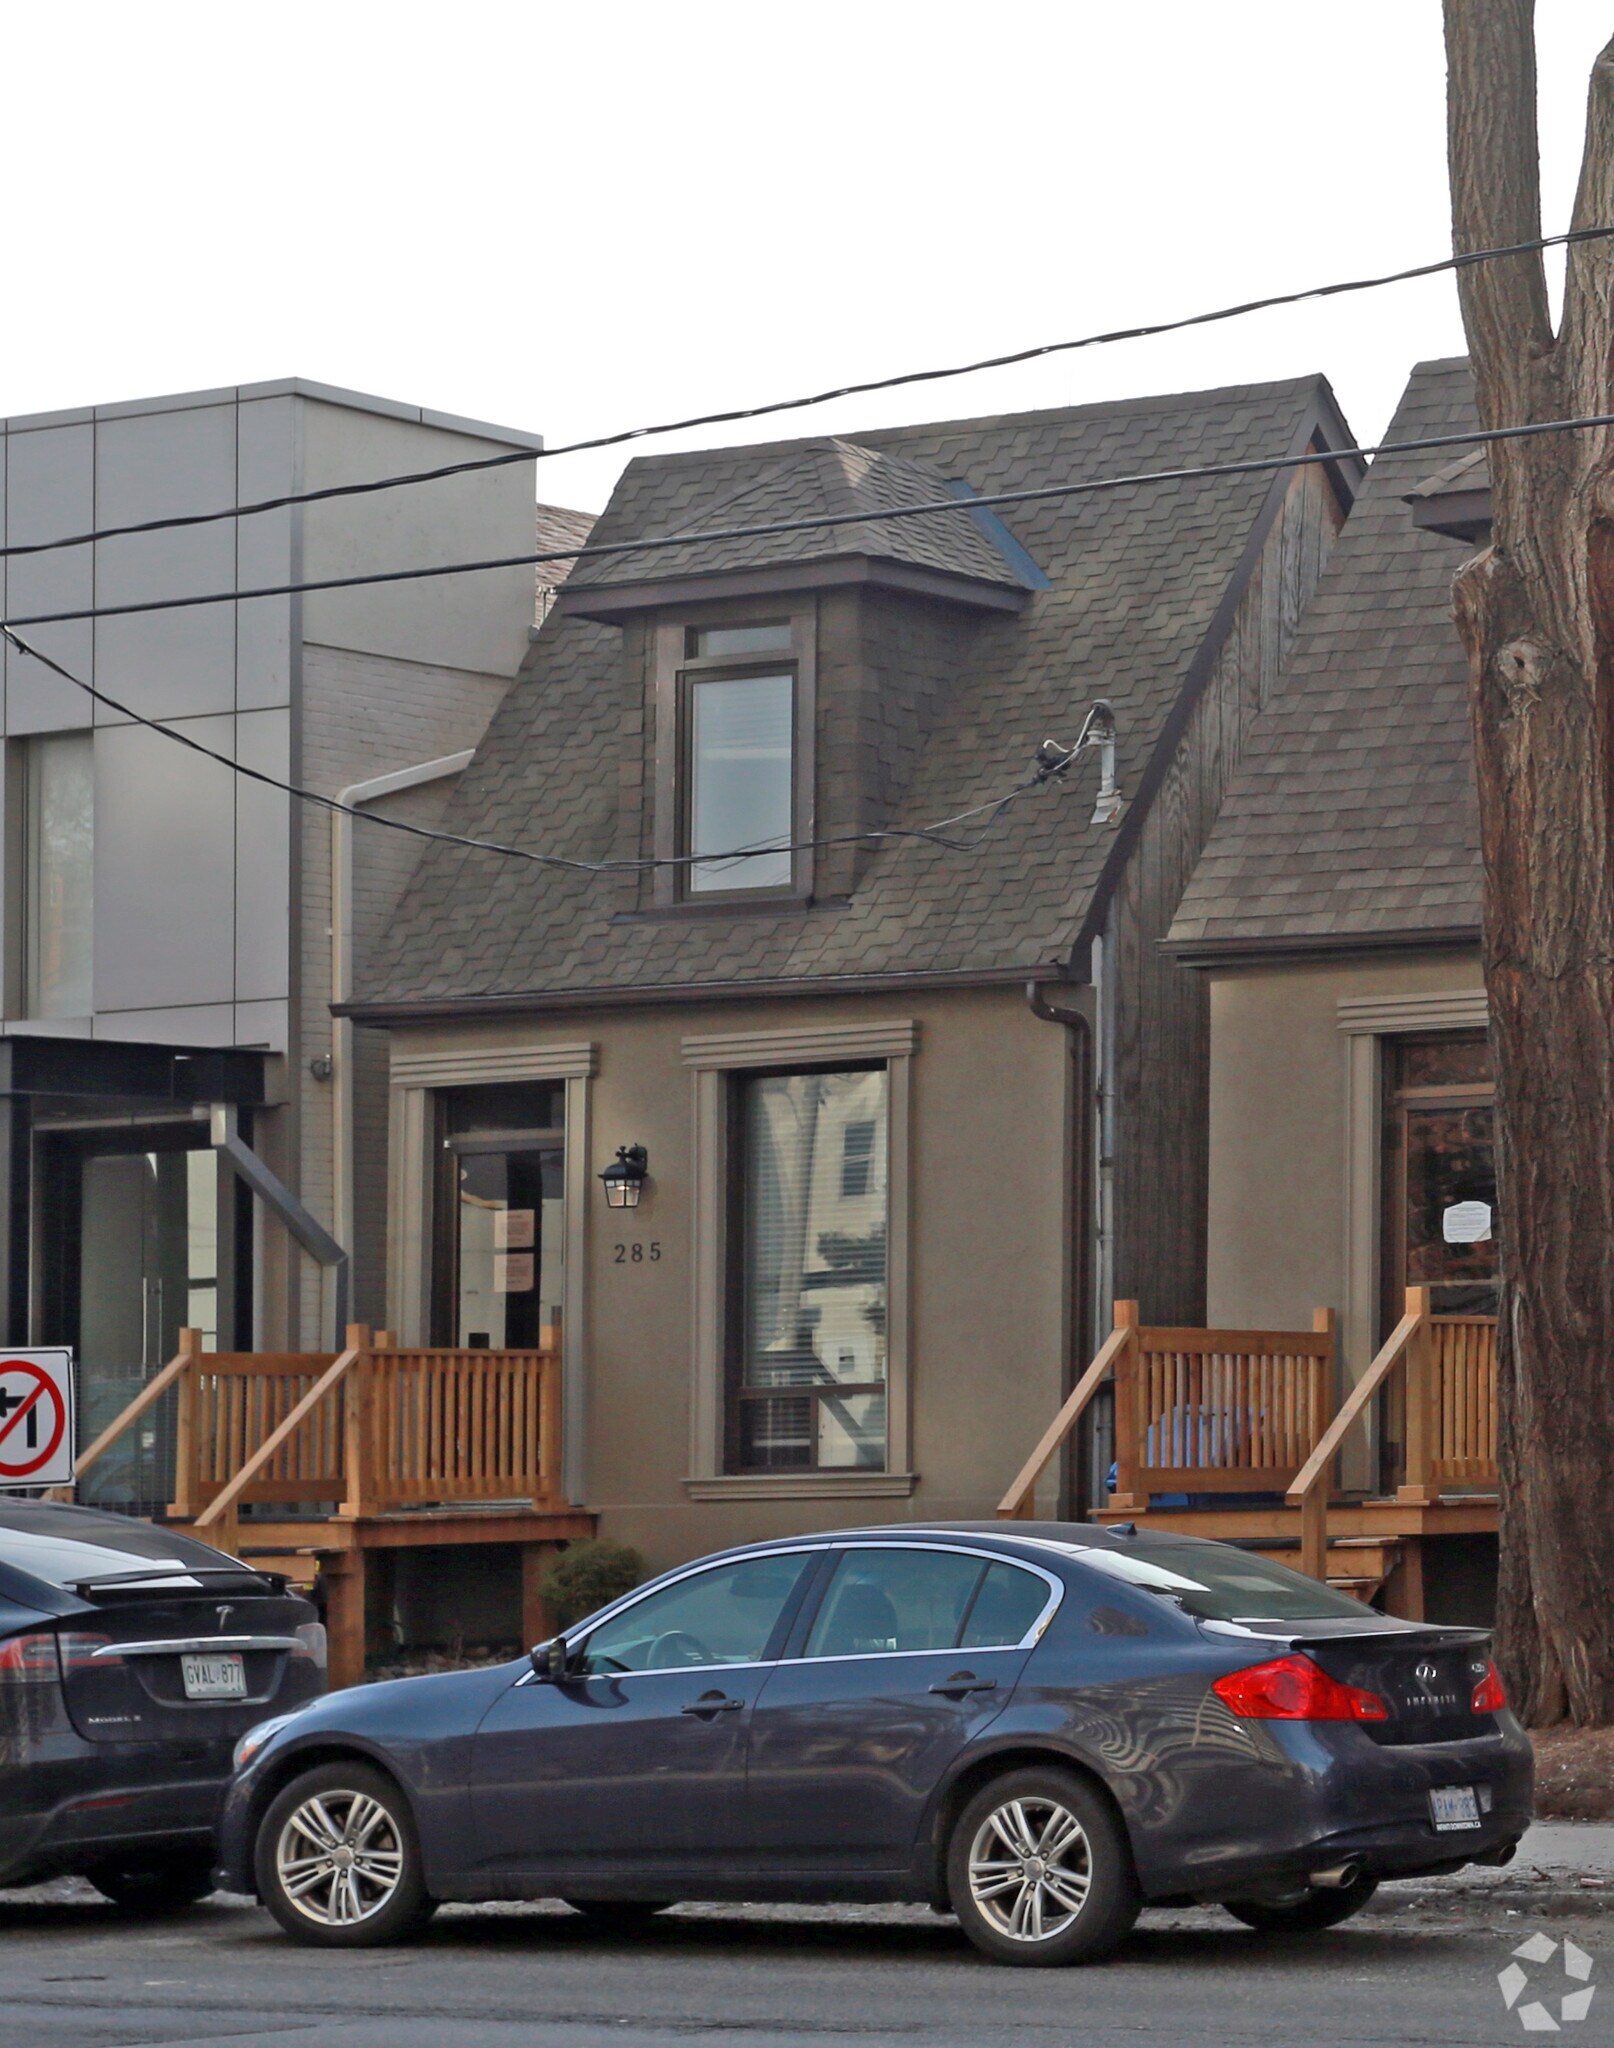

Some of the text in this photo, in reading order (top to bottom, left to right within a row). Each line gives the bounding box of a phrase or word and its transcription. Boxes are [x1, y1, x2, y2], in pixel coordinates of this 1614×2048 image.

[614, 1242, 661, 1263] 285
[186, 1663, 241, 1685] GVAL 877
